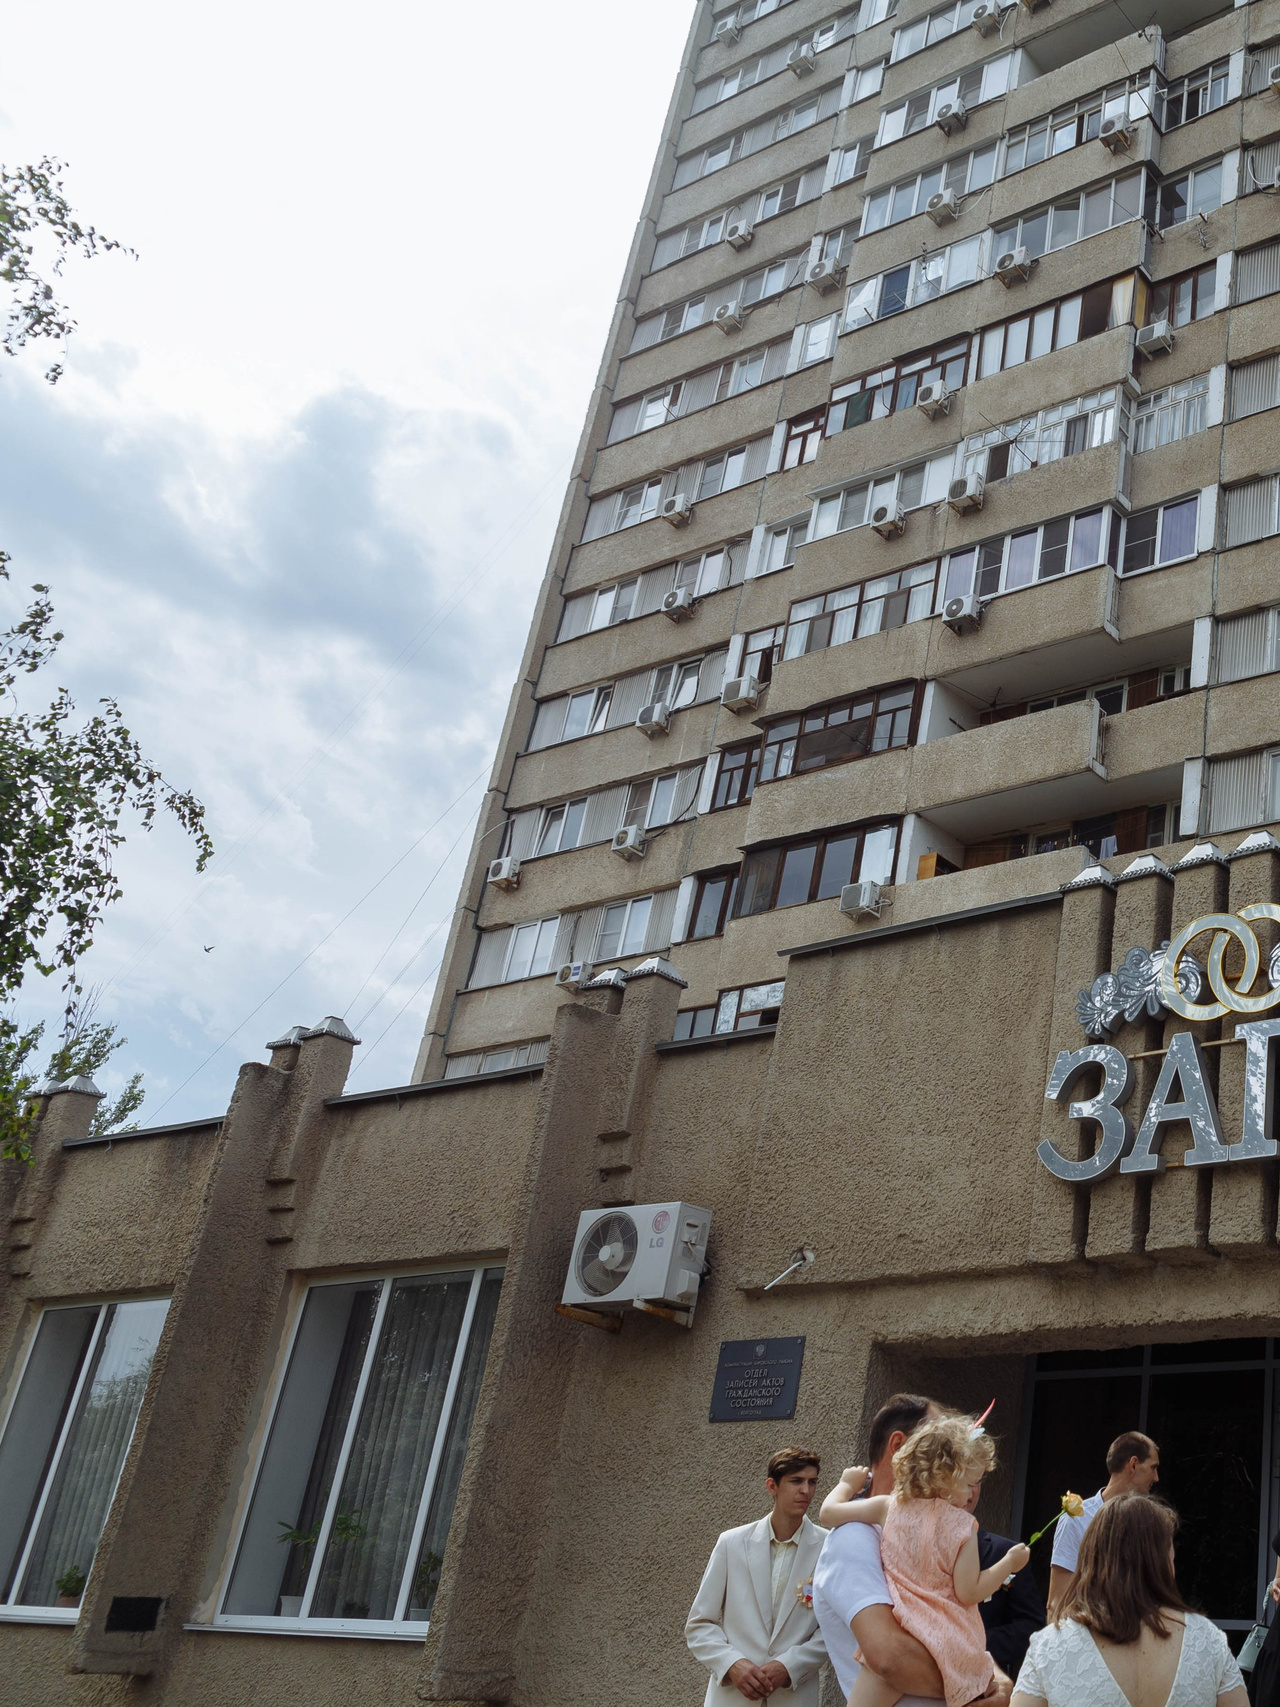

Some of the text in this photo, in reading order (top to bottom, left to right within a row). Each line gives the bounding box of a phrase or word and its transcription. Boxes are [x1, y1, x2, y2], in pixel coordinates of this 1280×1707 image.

[649, 1237, 664, 1248] LG
[744, 1368, 768, 1378] ОТДЕЛ
[725, 1377, 785, 1388] ЗАПИСЕЙ АКТОВ
[725, 1387, 781, 1399] ГРАЖДАНСКОГО
[730, 1397, 773, 1407] СОСТОЯНИЯ
